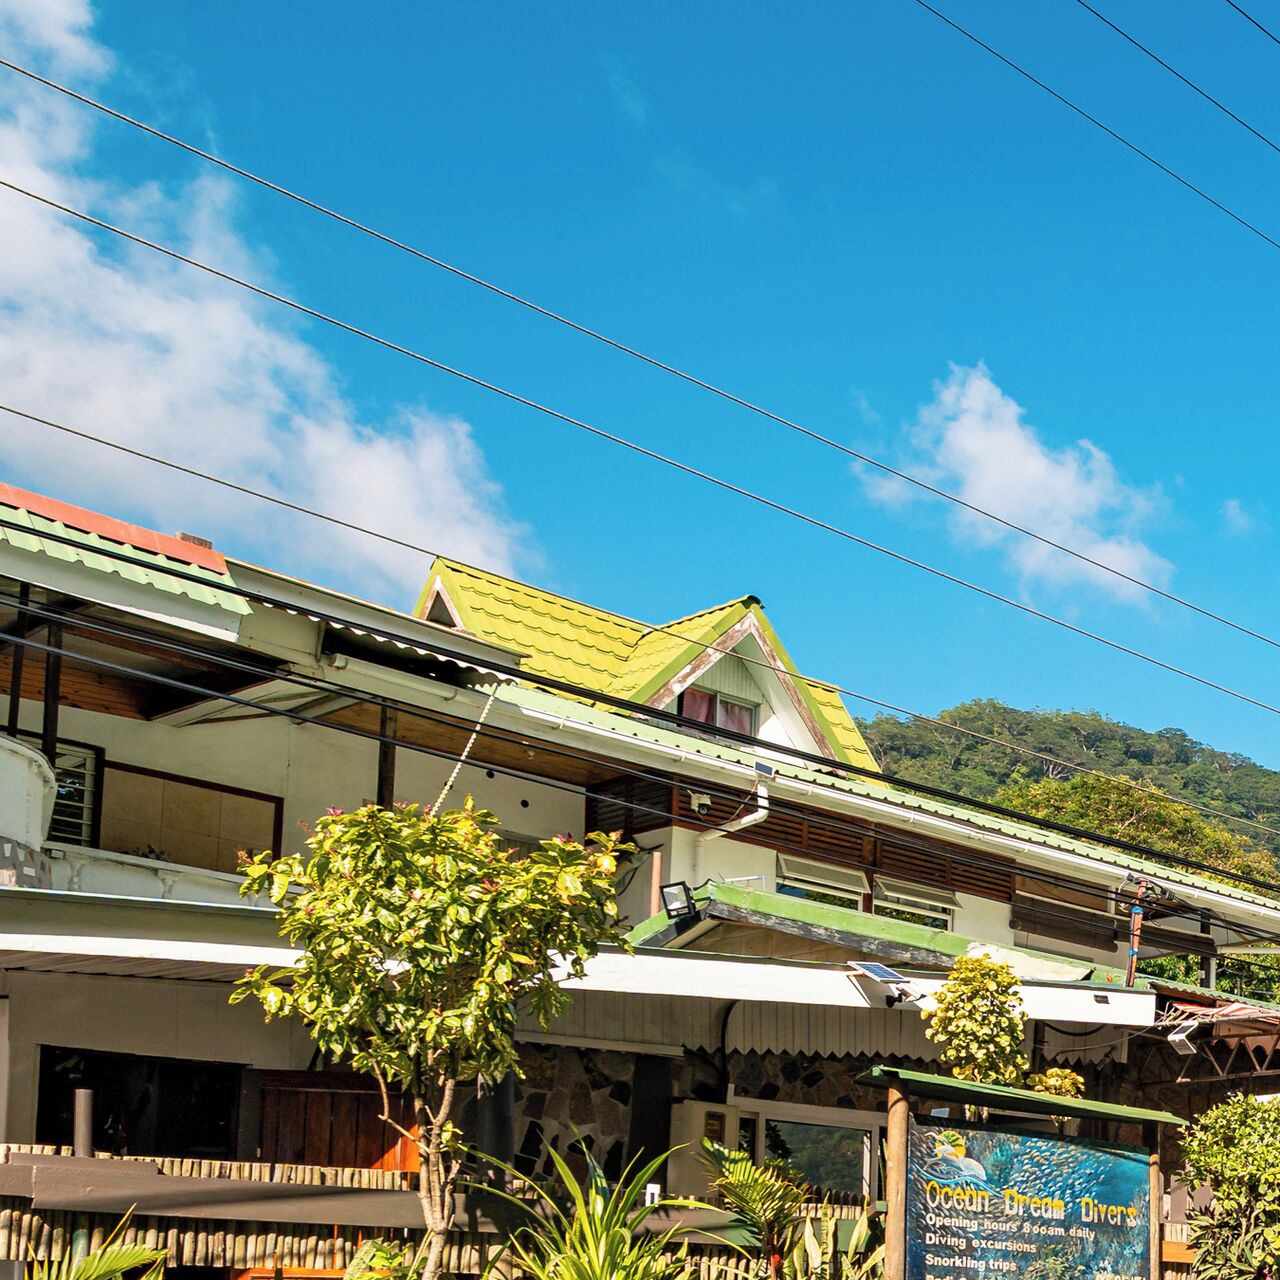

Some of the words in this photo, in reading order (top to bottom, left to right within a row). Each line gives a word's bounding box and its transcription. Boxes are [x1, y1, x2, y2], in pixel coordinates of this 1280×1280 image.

[925, 1180, 990, 1213] Ocean
[1004, 1188, 1065, 1220] Dream
[1081, 1197, 1138, 1228] Divers
[925, 1212, 978, 1232] Opening
[983, 1218, 1018, 1233] hours
[1069, 1228, 1096, 1242] daily
[925, 1233, 967, 1249] Diving
[971, 1238, 1037, 1254] excursions
[925, 1254, 986, 1272] Snorkling
[989, 1260, 1017, 1273] trips
